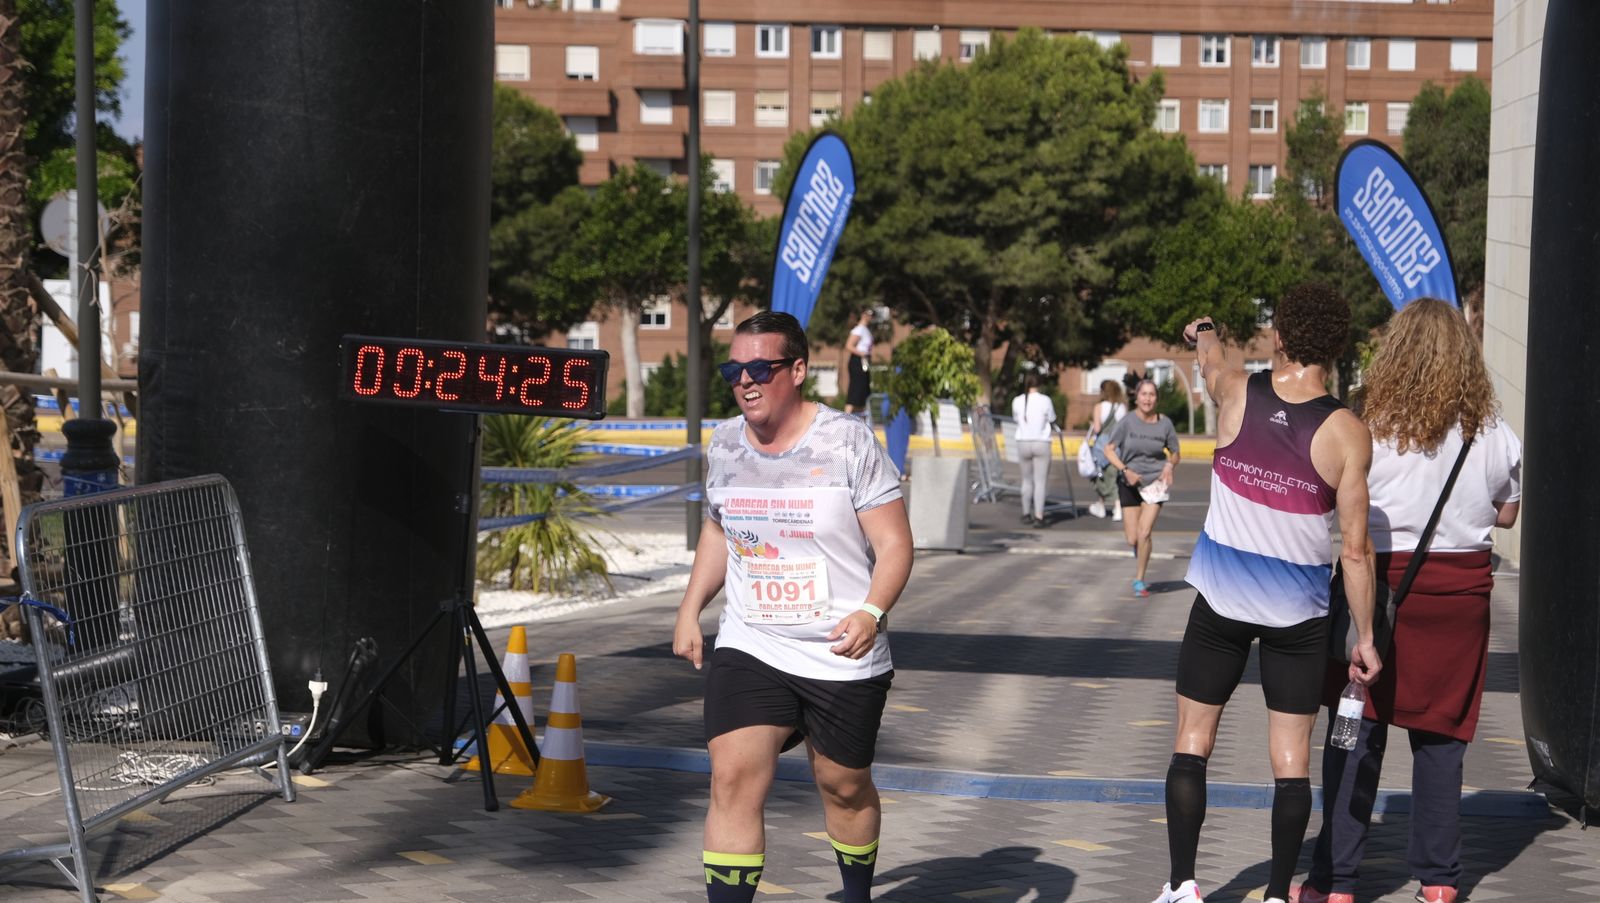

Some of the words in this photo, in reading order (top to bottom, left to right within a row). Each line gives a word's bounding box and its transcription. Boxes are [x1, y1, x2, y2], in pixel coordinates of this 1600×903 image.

[353, 345, 590, 409] 00:24:25
[1238, 474, 1288, 495] ALMERÍA
[1263, 470, 1319, 494] ATLETAS
[730, 498, 768, 509] CARRERA
[770, 499, 786, 509] SIN
[788, 499, 814, 510] HUMO
[789, 530, 814, 539] JUNIO
[751, 580, 816, 602] 1091
